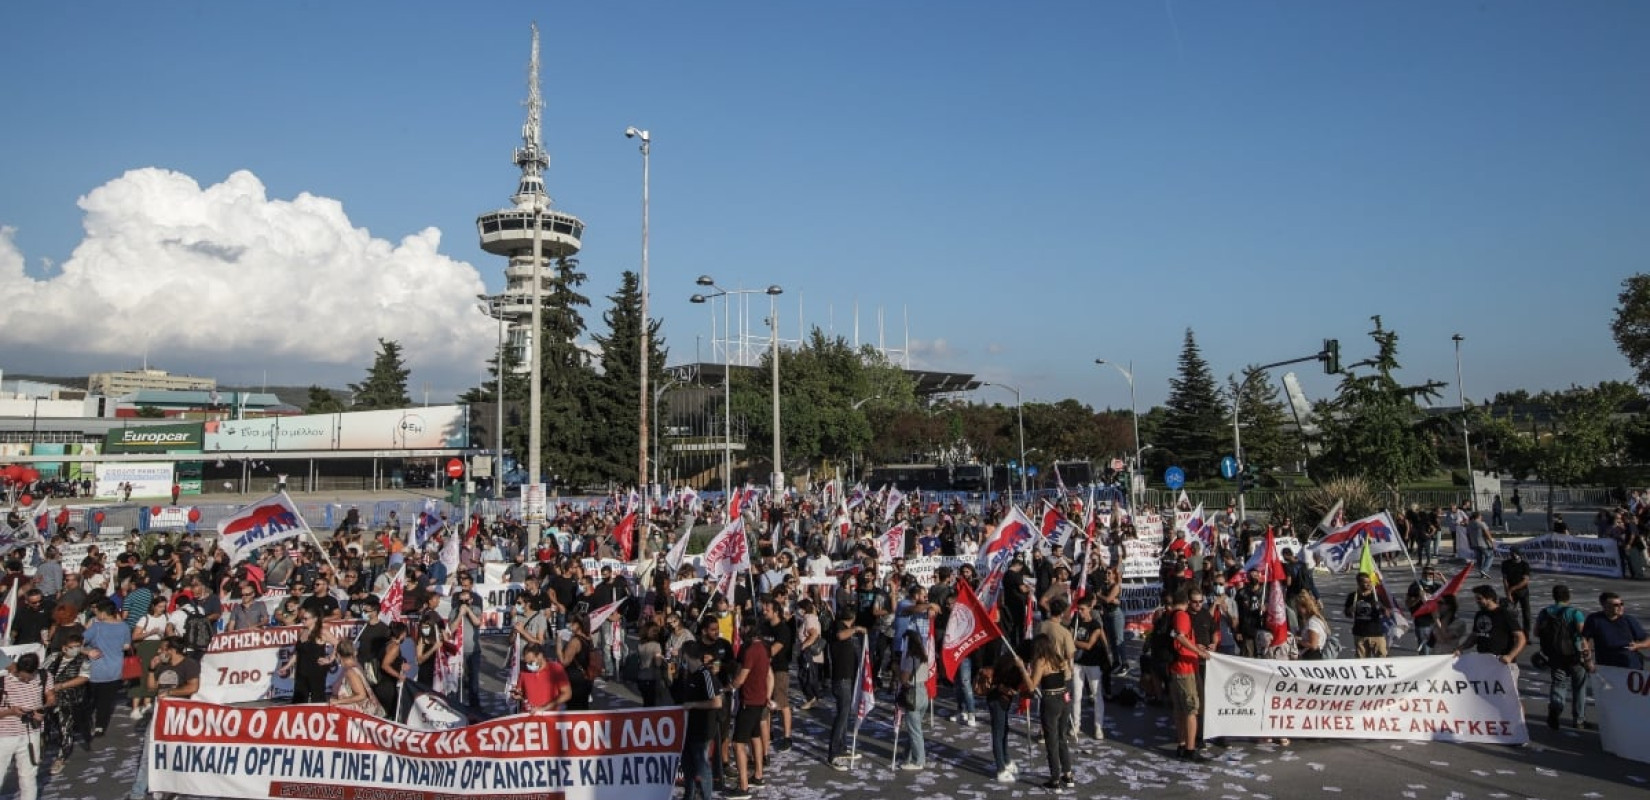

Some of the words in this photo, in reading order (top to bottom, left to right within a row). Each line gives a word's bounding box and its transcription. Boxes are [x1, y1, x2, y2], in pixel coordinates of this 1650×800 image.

[122, 430, 190, 445] Europcar
[1277, 665, 1297, 678] ΟΙ
[1299, 665, 1358, 680] ΝΟΜΟΙ
[1362, 664, 1398, 679] ΣΑΣ
[1275, 680, 1299, 694] ΘΑ
[1307, 683, 1386, 696] ΜΕΙΝΟΥΝ
[1390, 681, 1420, 695] ΣΤΑ
[1427, 679, 1506, 695] ΧΑΡΤΙΑ
[1270, 696, 1354, 711] ΒΑΖΟΥΜΕ
[163, 706, 242, 737] ΜΟΝΟ
[249, 710, 267, 739] Ο
[273, 711, 340, 741] ΛΑΟΣ
[346, 716, 430, 753] ΜΠΟΡΕΙ
[434, 729, 472, 755] ΝΑ
[477, 721, 549, 752] ΣΩΣΕΙ
[555, 720, 611, 750] ΤΟΝ
[620, 716, 676, 748] ΛΑΟ
[1269, 715, 1295, 729] ΤΙΣ
[1302, 715, 1355, 730] ΔΙΚΕΣ
[1363, 716, 1401, 732] ΜΑΣ
[1409, 717, 1512, 736] ΑΝΑΓΚΕΣ
[154, 744, 168, 771] Η
[172, 746, 240, 775] ΔΙΚΑΙΗ
[244, 747, 296, 777] ΟΡΓΗ
[299, 749, 325, 779] ΝΑ
[329, 751, 378, 782] ΓΙΝΕΙ
[382, 754, 457, 787] ΔΥΝΑΜΗ
[460, 757, 574, 790] ΟΡΓΑΝΩΣΗΣ
[579, 757, 614, 786] ΚΑΙ
